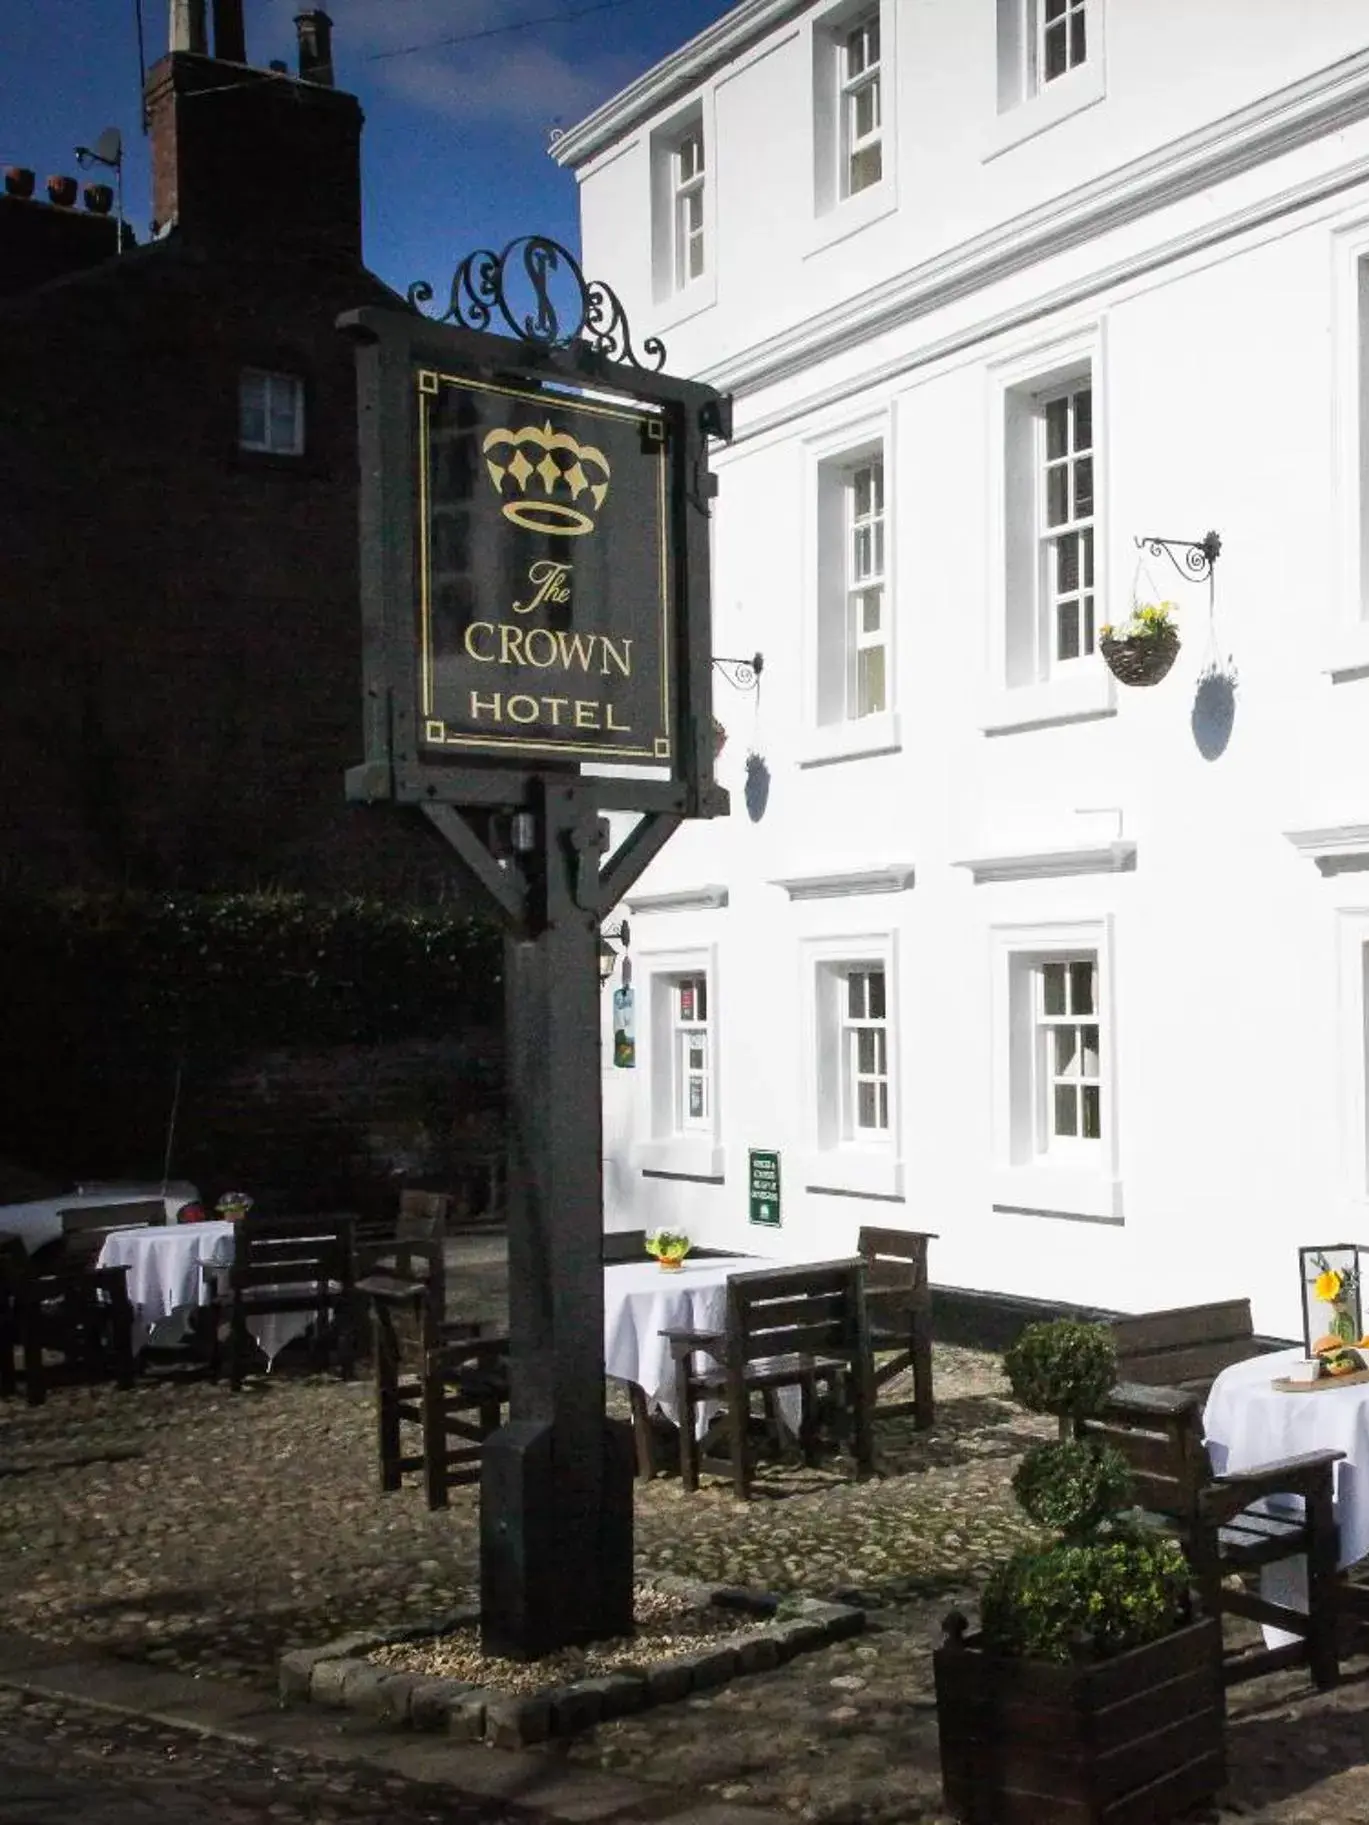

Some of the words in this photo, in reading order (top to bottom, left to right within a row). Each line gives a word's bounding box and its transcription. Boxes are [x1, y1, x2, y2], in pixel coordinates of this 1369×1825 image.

[512, 560, 574, 615] The
[464, 621, 633, 676] CROWN
[470, 691, 632, 731] HOTEL
